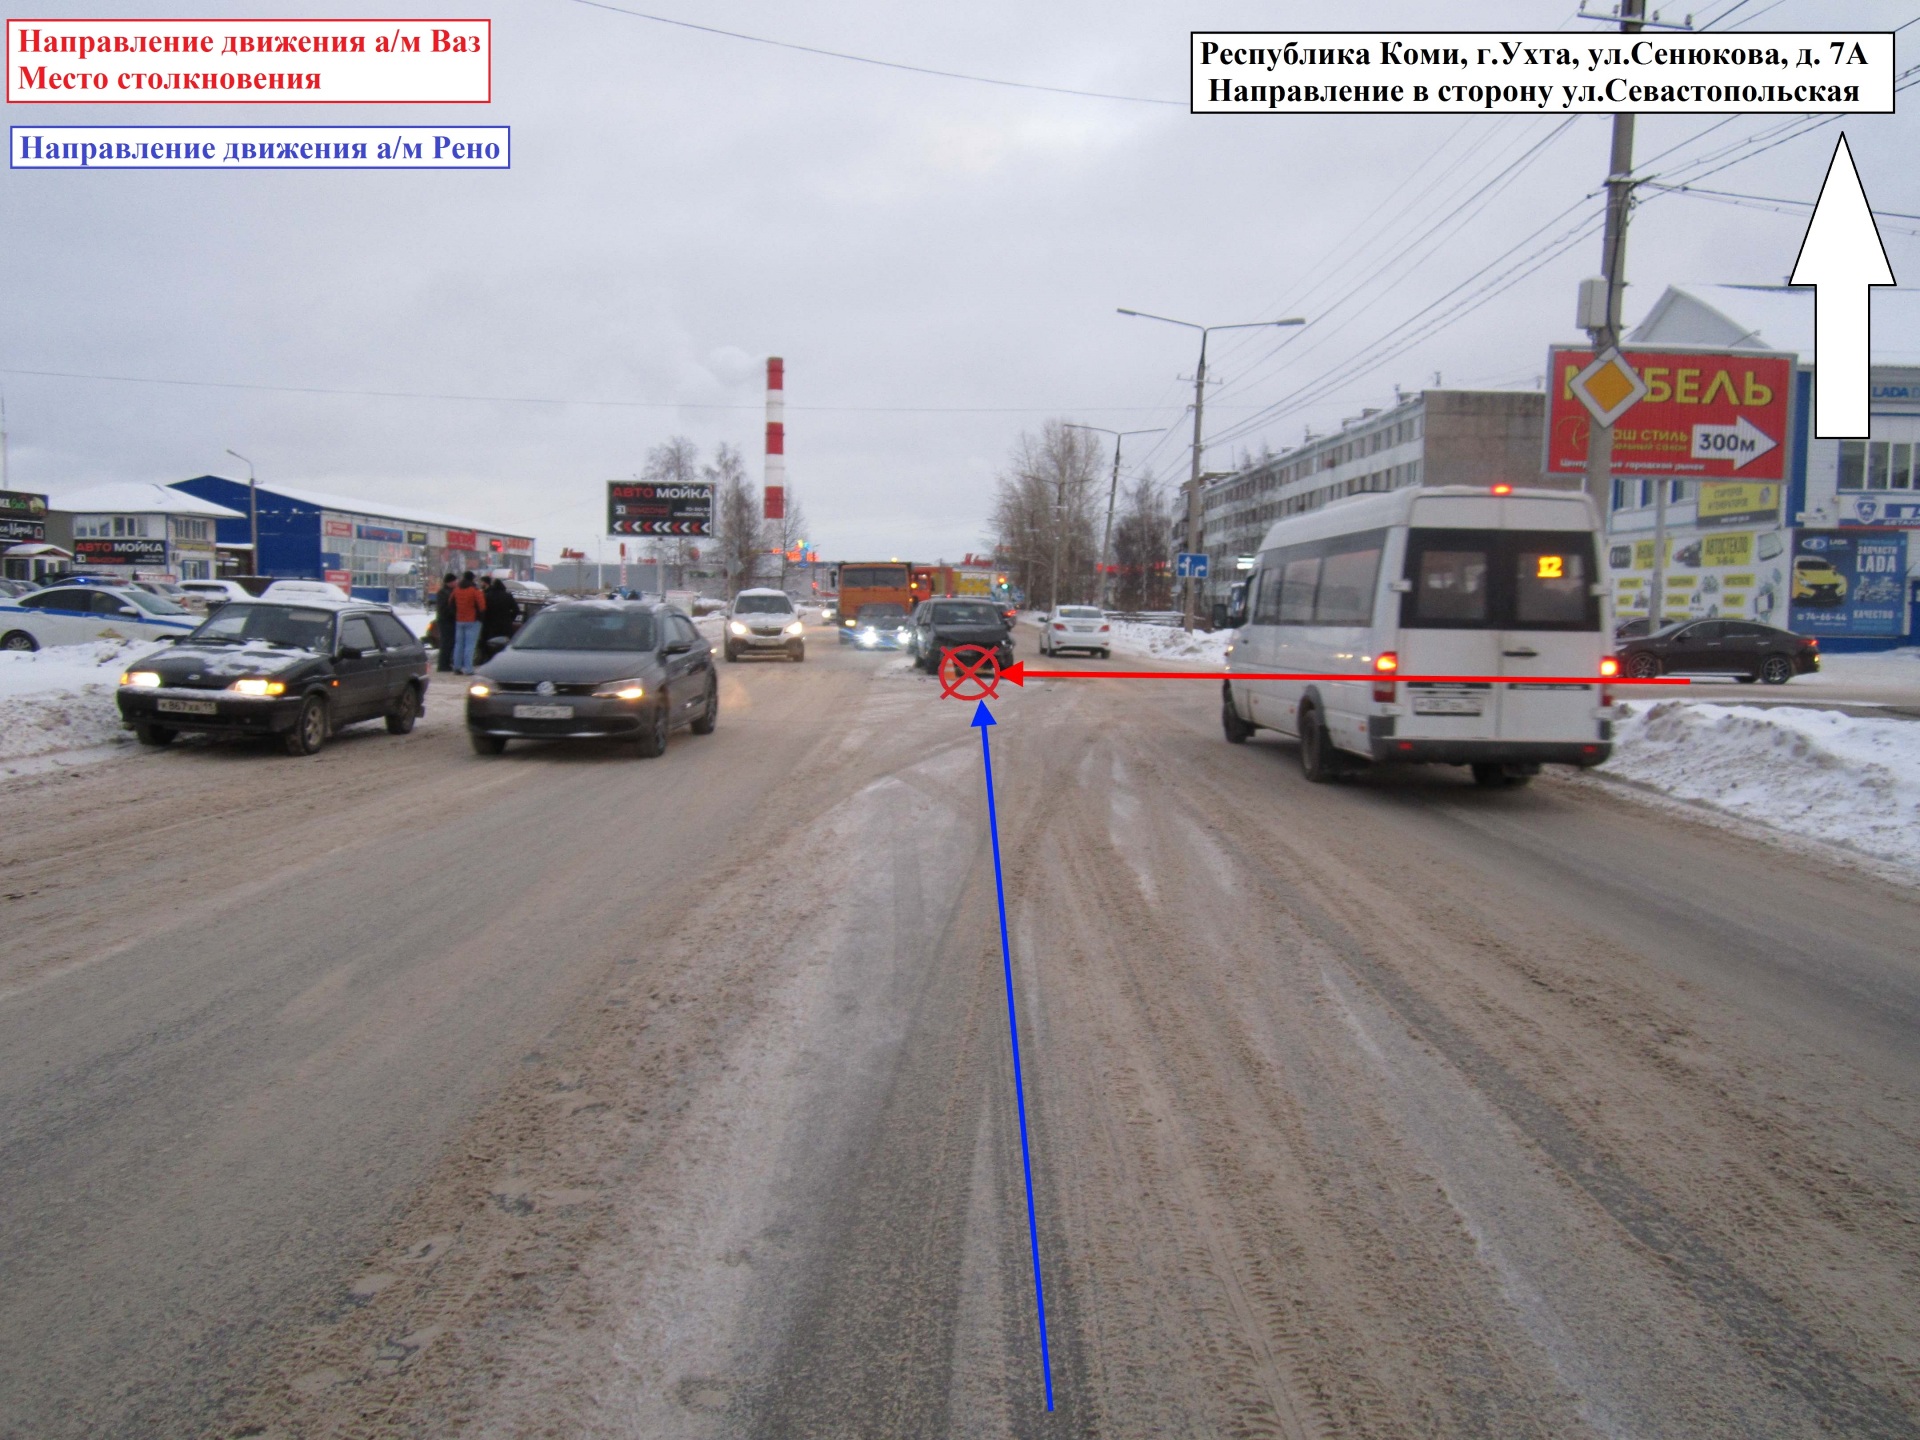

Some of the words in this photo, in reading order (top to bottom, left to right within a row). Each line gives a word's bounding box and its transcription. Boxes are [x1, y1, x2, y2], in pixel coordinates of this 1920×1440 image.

[1563, 364, 1774, 407] БЕЛЬ
[1872, 386, 1909, 398] LADA
[1699, 433, 1756, 452] 300м
[613, 487, 655, 498] АВТО
[656, 486, 712, 499] МОЙКА
[76, 543, 112, 552] АВТО
[115, 541, 164, 553] МОЙКА
[1537, 556, 1563, 577] 12
[1856, 555, 1897, 573] LADA
